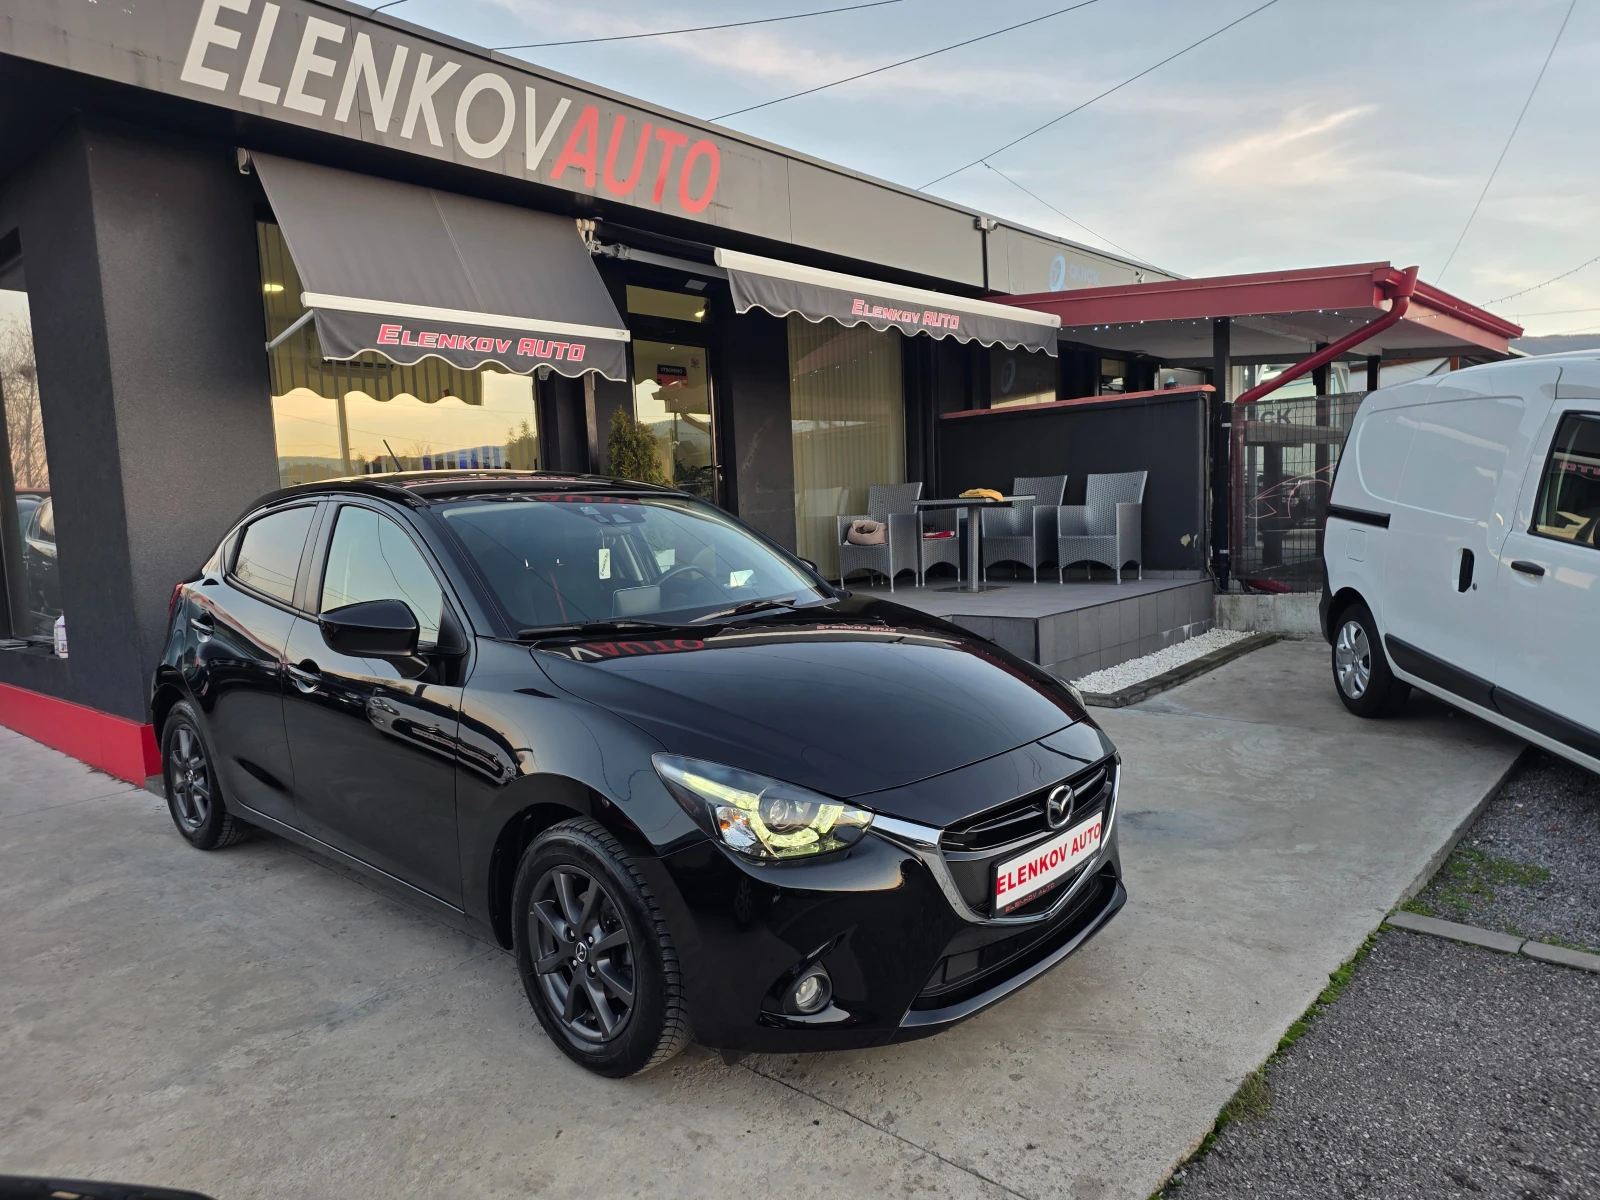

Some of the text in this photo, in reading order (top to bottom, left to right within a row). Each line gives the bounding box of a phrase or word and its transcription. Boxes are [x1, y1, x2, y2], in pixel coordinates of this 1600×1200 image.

[852, 298, 960, 330] ELENKOV AUTO
[377, 323, 586, 362] ELENKOV AUTO
[996, 843, 1067, 895] ELENKOV
[1070, 822, 1101, 857] AUTO
